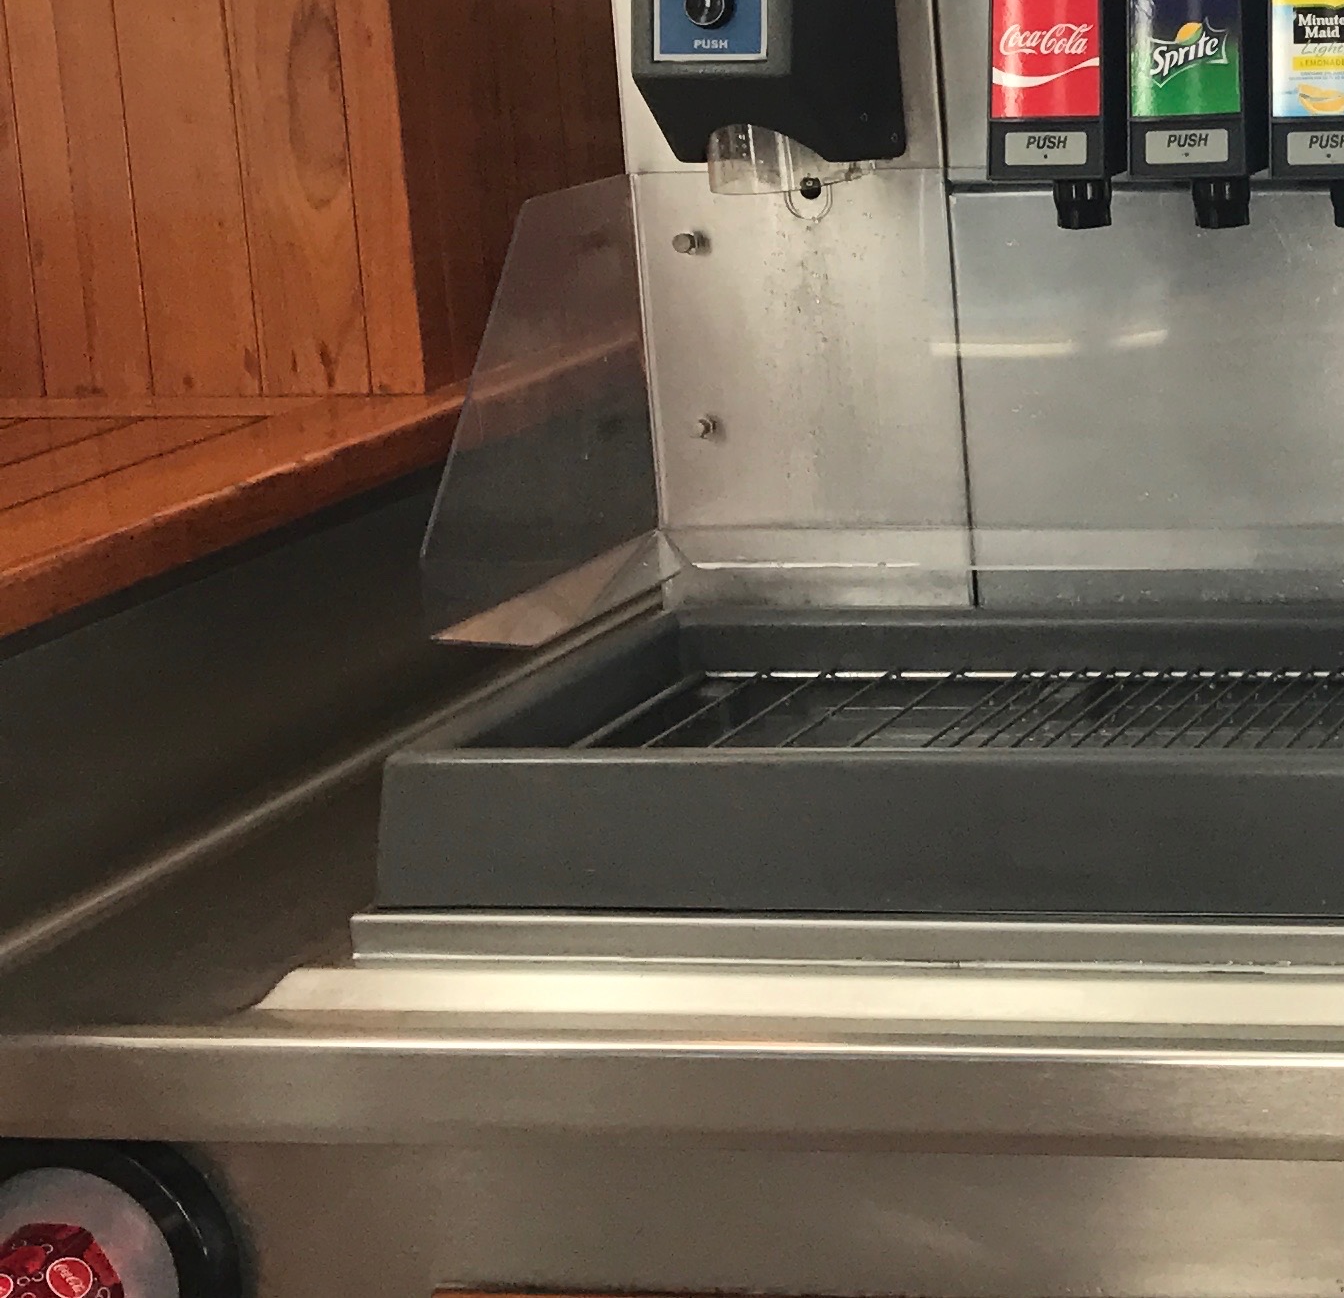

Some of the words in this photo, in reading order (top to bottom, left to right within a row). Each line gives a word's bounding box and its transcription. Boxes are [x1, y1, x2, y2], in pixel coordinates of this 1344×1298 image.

[999, 23, 1093, 55] Coca-Cola
[1304, 25, 1340, 38] Maid
[694, 39, 728, 49] PUSH
[1301, 39, 1344, 57] Light
[1150, 32, 1219, 76] Sprite
[1026, 135, 1068, 149] PUSH
[1167, 133, 1209, 148] PUSH
